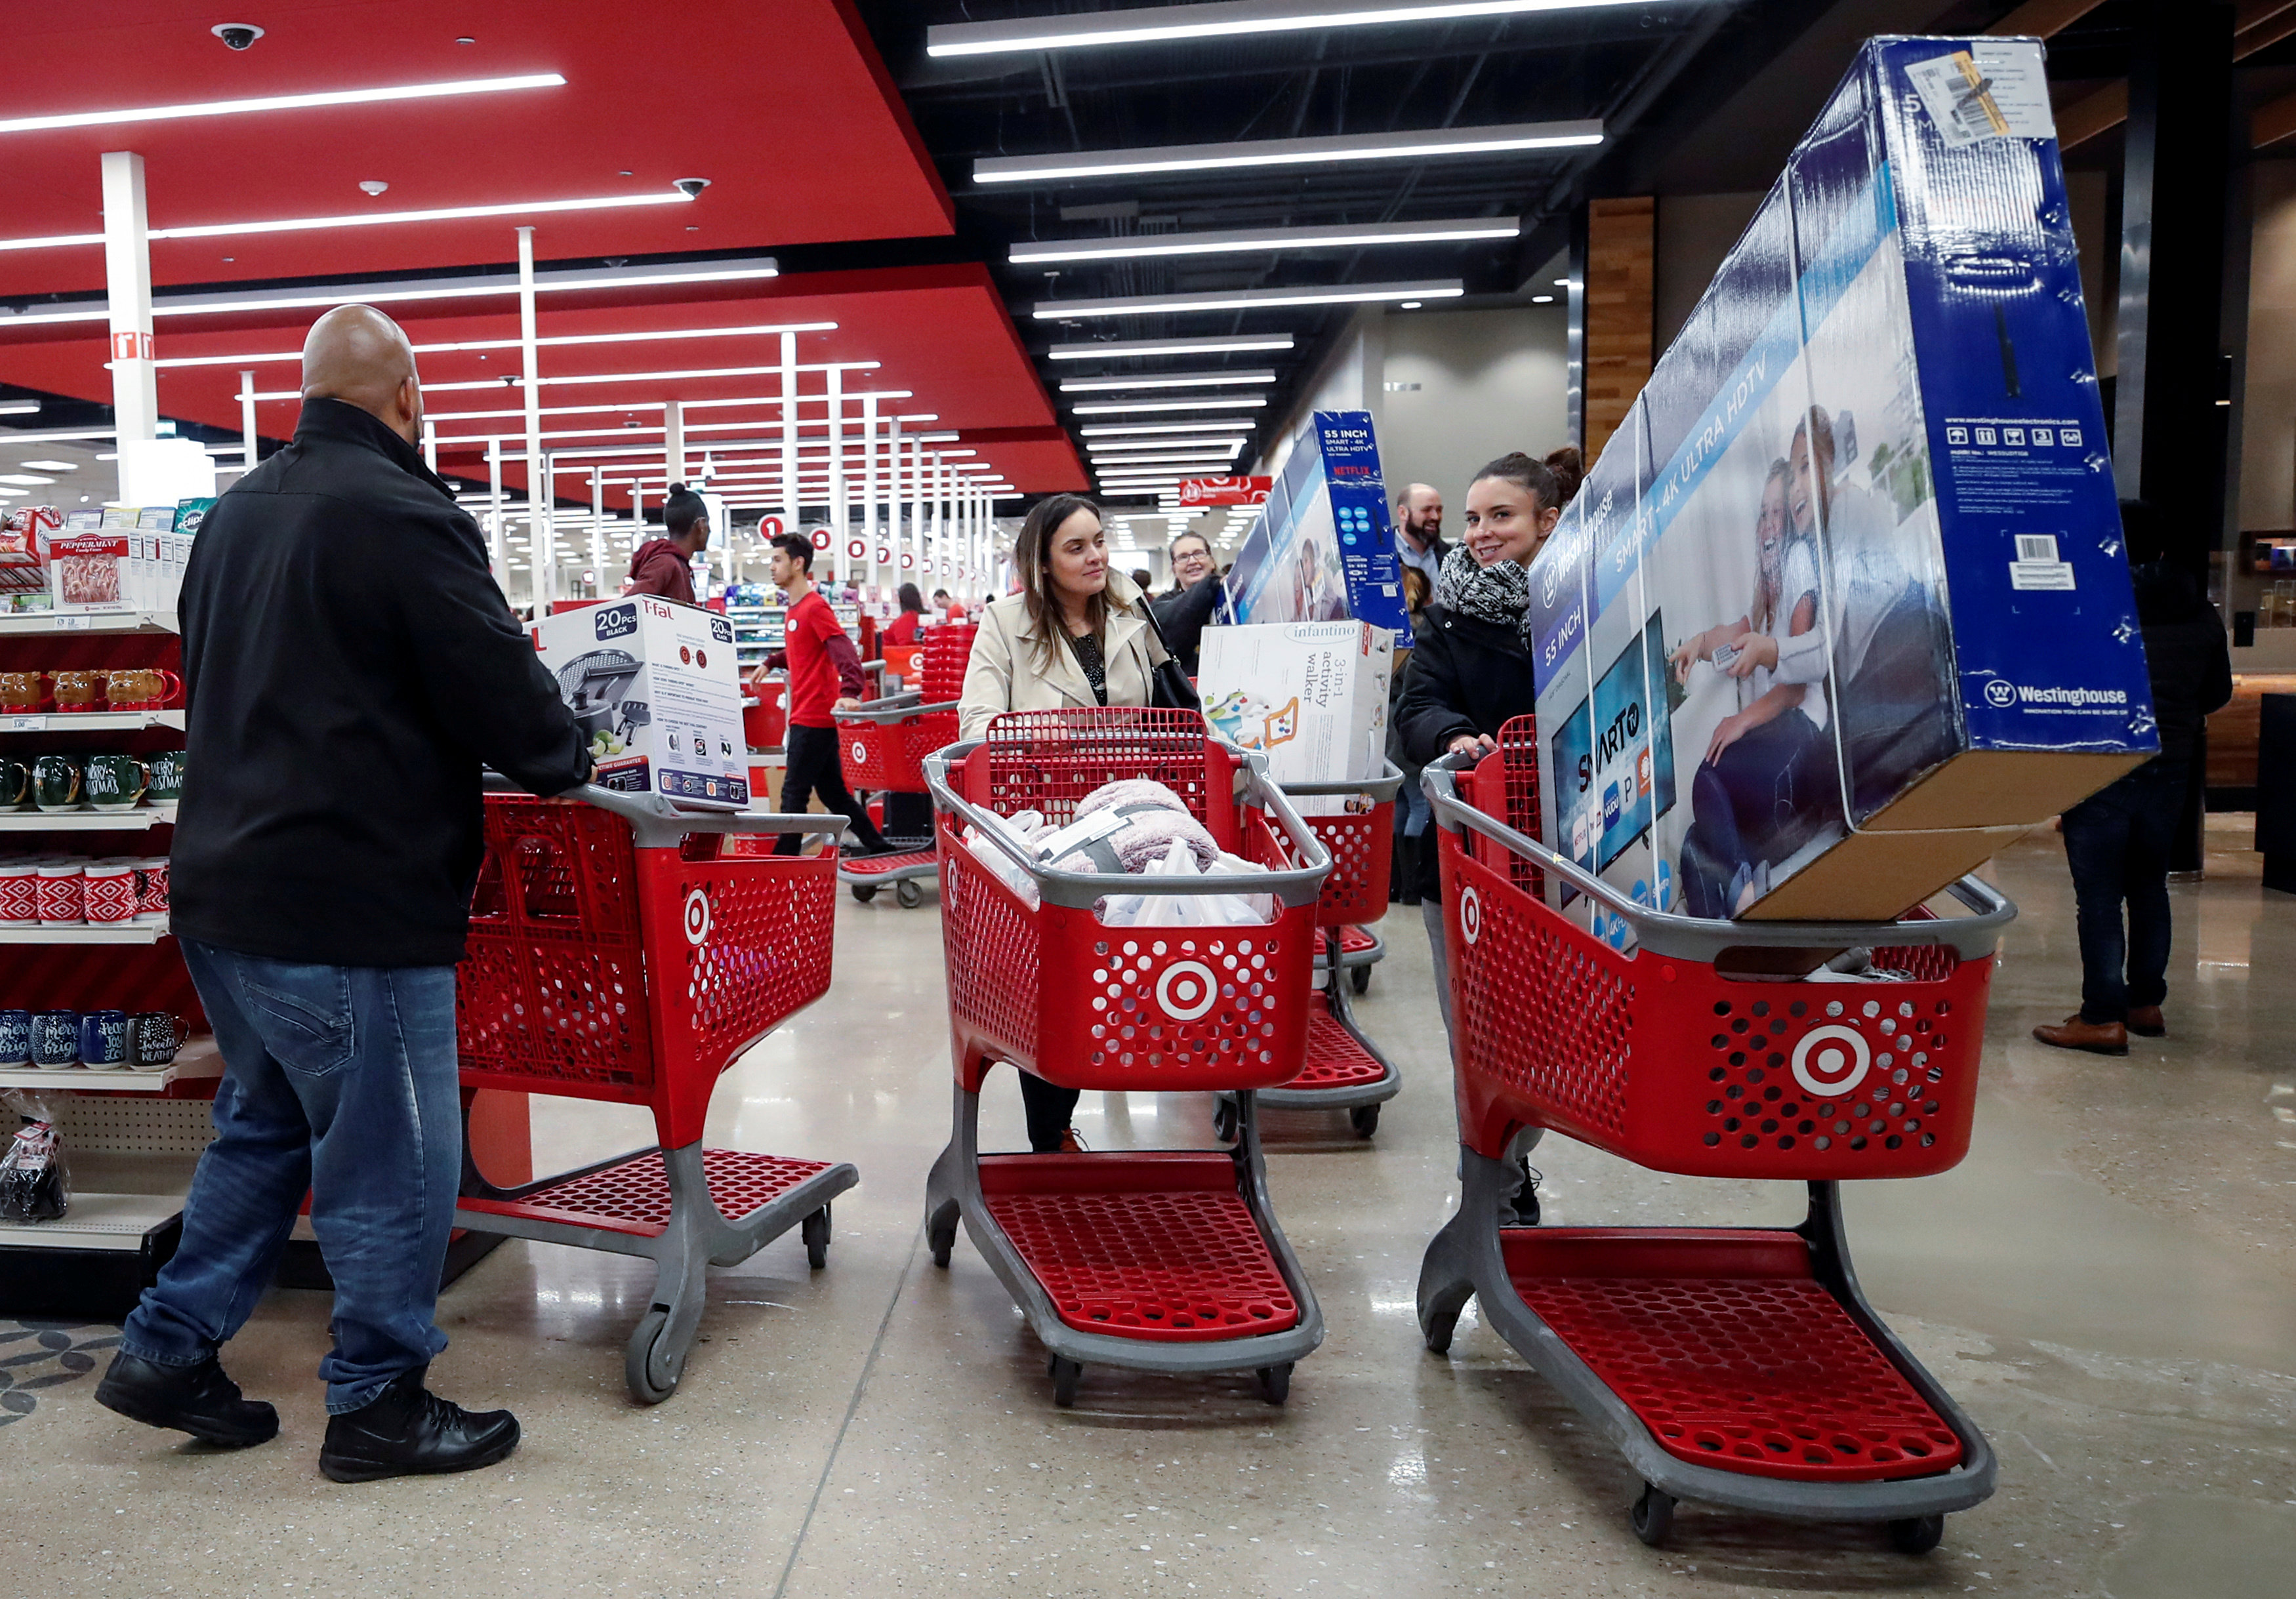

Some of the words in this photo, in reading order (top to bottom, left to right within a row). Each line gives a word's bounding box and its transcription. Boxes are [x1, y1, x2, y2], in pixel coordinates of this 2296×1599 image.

[1324, 429, 1338, 438] 55
[1340, 430, 1368, 438] INCH
[1616, 505, 1654, 573] SMART
[1662, 474, 1679, 507] 4K
[1681, 414, 1725, 483] ULTRA
[1726, 351, 1767, 424] HDTV
[1334, 466, 1370, 476] NETFLIX
[177, 514, 204, 529] eclips
[766, 521, 775, 536] 1
[37, 529, 50, 543] Trid
[60, 540, 119, 550] PEPPERMINT
[606, 626, 628, 636] BLACK
[1294, 624, 1355, 638] infantino
[1546, 638, 1557, 667] 55
[1558, 605, 1581, 650] INCH
[1303, 653, 1319, 703] walker
[1315, 651, 1332, 708] activity
[1333, 658, 1347, 697] 3-in-1
[2017, 686, 2127, 706] Westinghouse
[1578, 707, 1626, 793] SMART
[150, 761, 175, 777] MERRY
[85, 779, 119, 796] RISTMAS
[1624, 776, 1632, 803] P
[1604, 796, 1620, 819] VUDU
[100, 1022, 125, 1036] Peac
